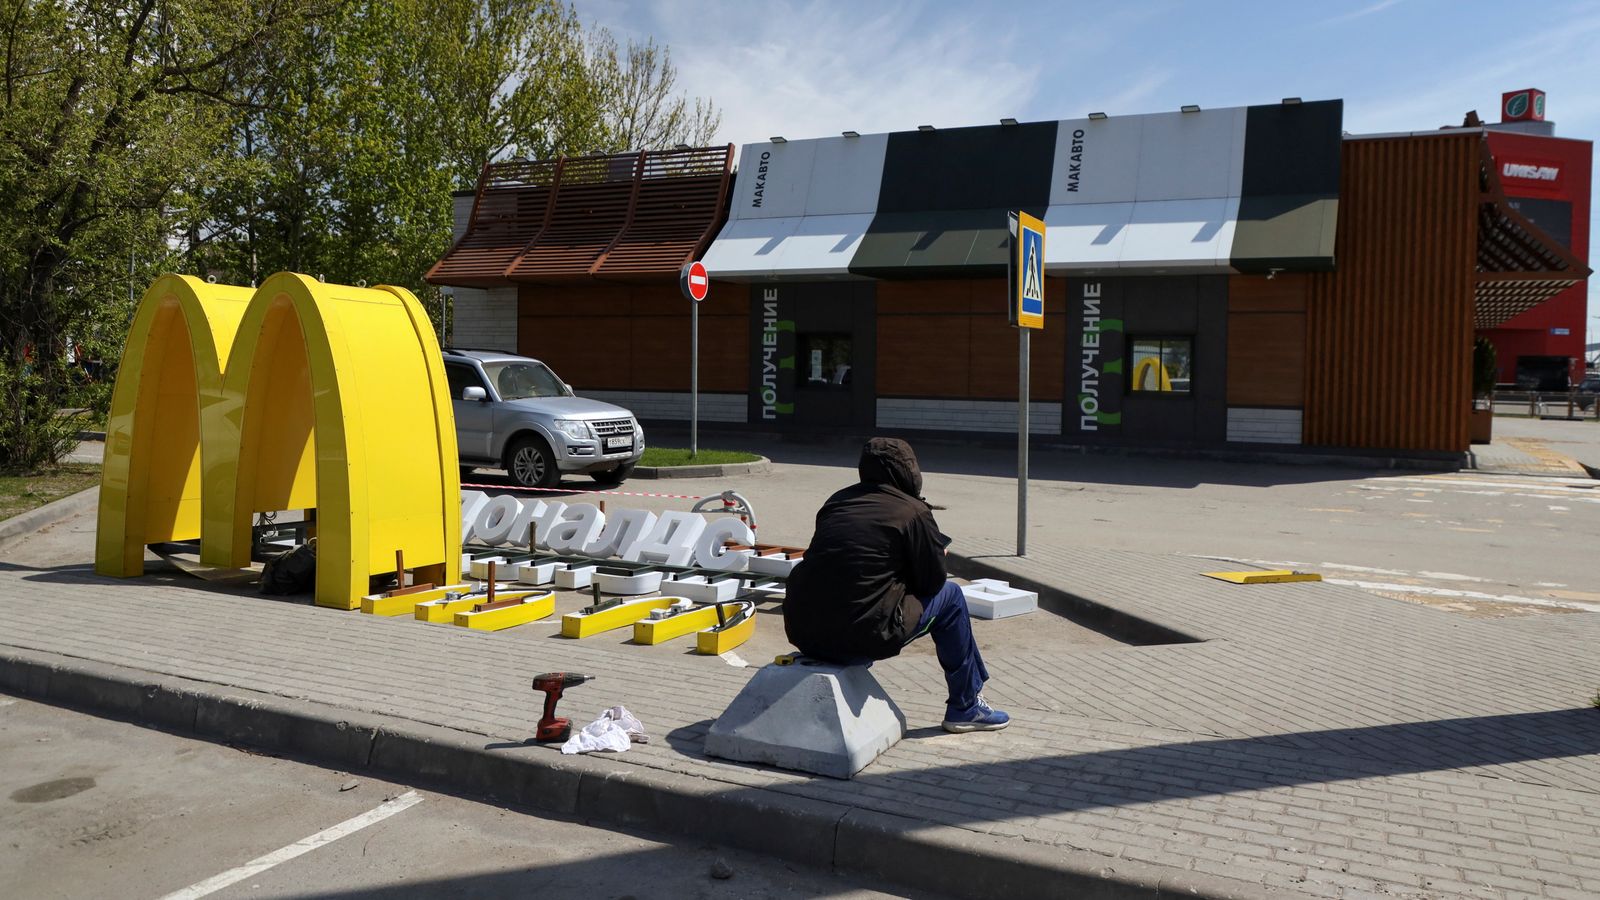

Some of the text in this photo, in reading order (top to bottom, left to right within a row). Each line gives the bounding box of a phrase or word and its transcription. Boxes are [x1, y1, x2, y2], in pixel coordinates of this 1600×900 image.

[752, 151, 771, 208] МАКАВТО
[1067, 129, 1085, 192] МАКАВТО
[762, 288, 778, 419] ПОЛУЧЕНИЕ
[1080, 283, 1101, 431] ПОЛУЧЕНИЕ
